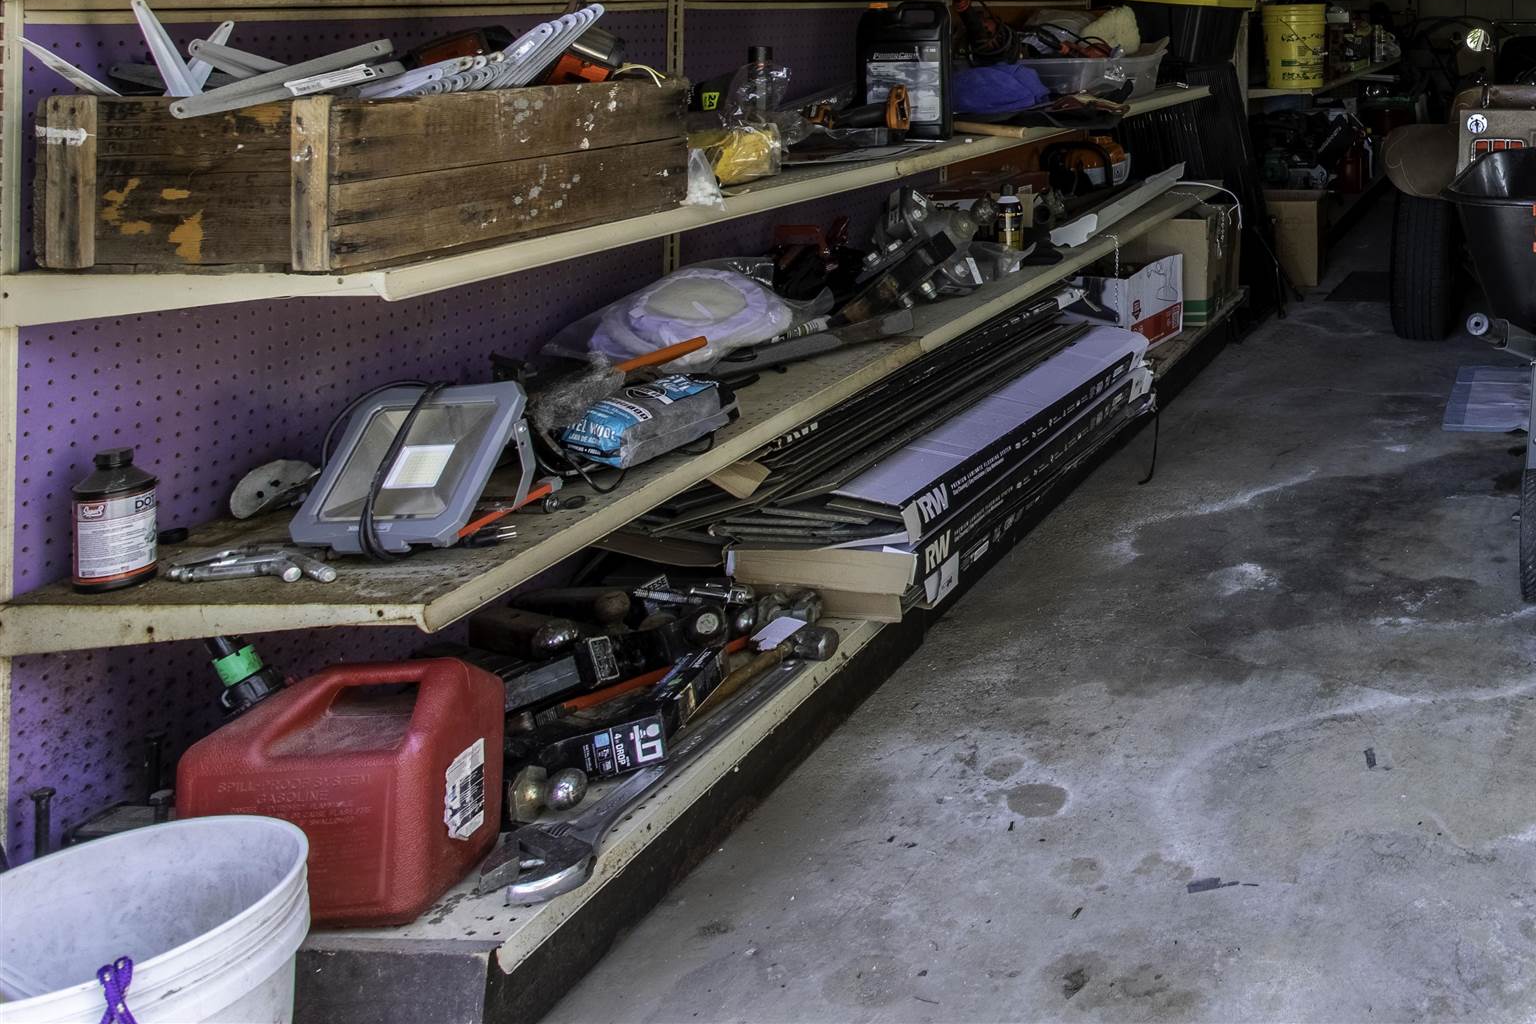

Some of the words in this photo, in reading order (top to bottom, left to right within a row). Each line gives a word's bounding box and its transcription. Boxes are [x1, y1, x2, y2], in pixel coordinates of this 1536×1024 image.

[135, 494, 156, 509] DOT
[925, 529, 951, 574] RW
[615, 743, 626, 766] DROP
[256, 789, 329, 805] GASOLINE
